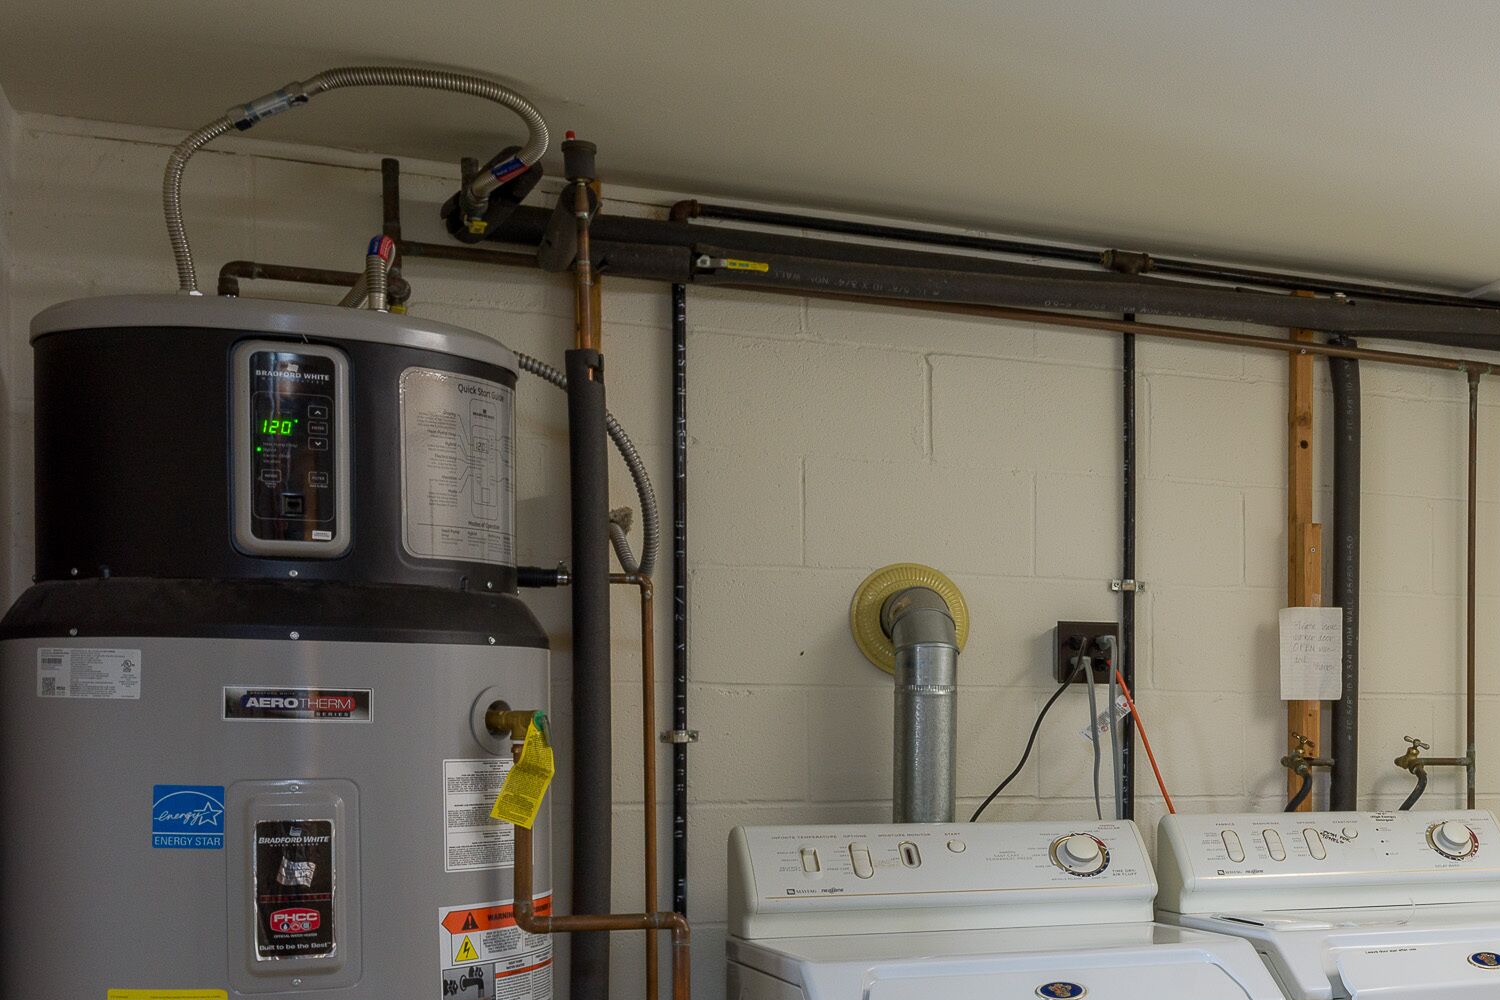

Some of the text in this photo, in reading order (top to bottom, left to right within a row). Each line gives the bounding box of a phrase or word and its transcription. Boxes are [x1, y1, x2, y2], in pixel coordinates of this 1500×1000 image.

[255, 369, 330, 382] BRADFORD WHITE
[457, 383, 505, 403] Quick Start Guide
[1346, 599, 1354, 623] WALL
[1346, 627, 1354, 646] NOM
[1346, 649, 1354, 671] 3/4"
[1346, 682, 1354, 692] ID
[245, 697, 351, 709] AEROTHERM
[158, 810, 202, 826] energy
[154, 836, 221, 847] ENERGY STAR
[258, 836, 302, 845] BRADFORD
[273, 913, 319, 923] PHCC
[487, 911, 514, 922] WARNIN
